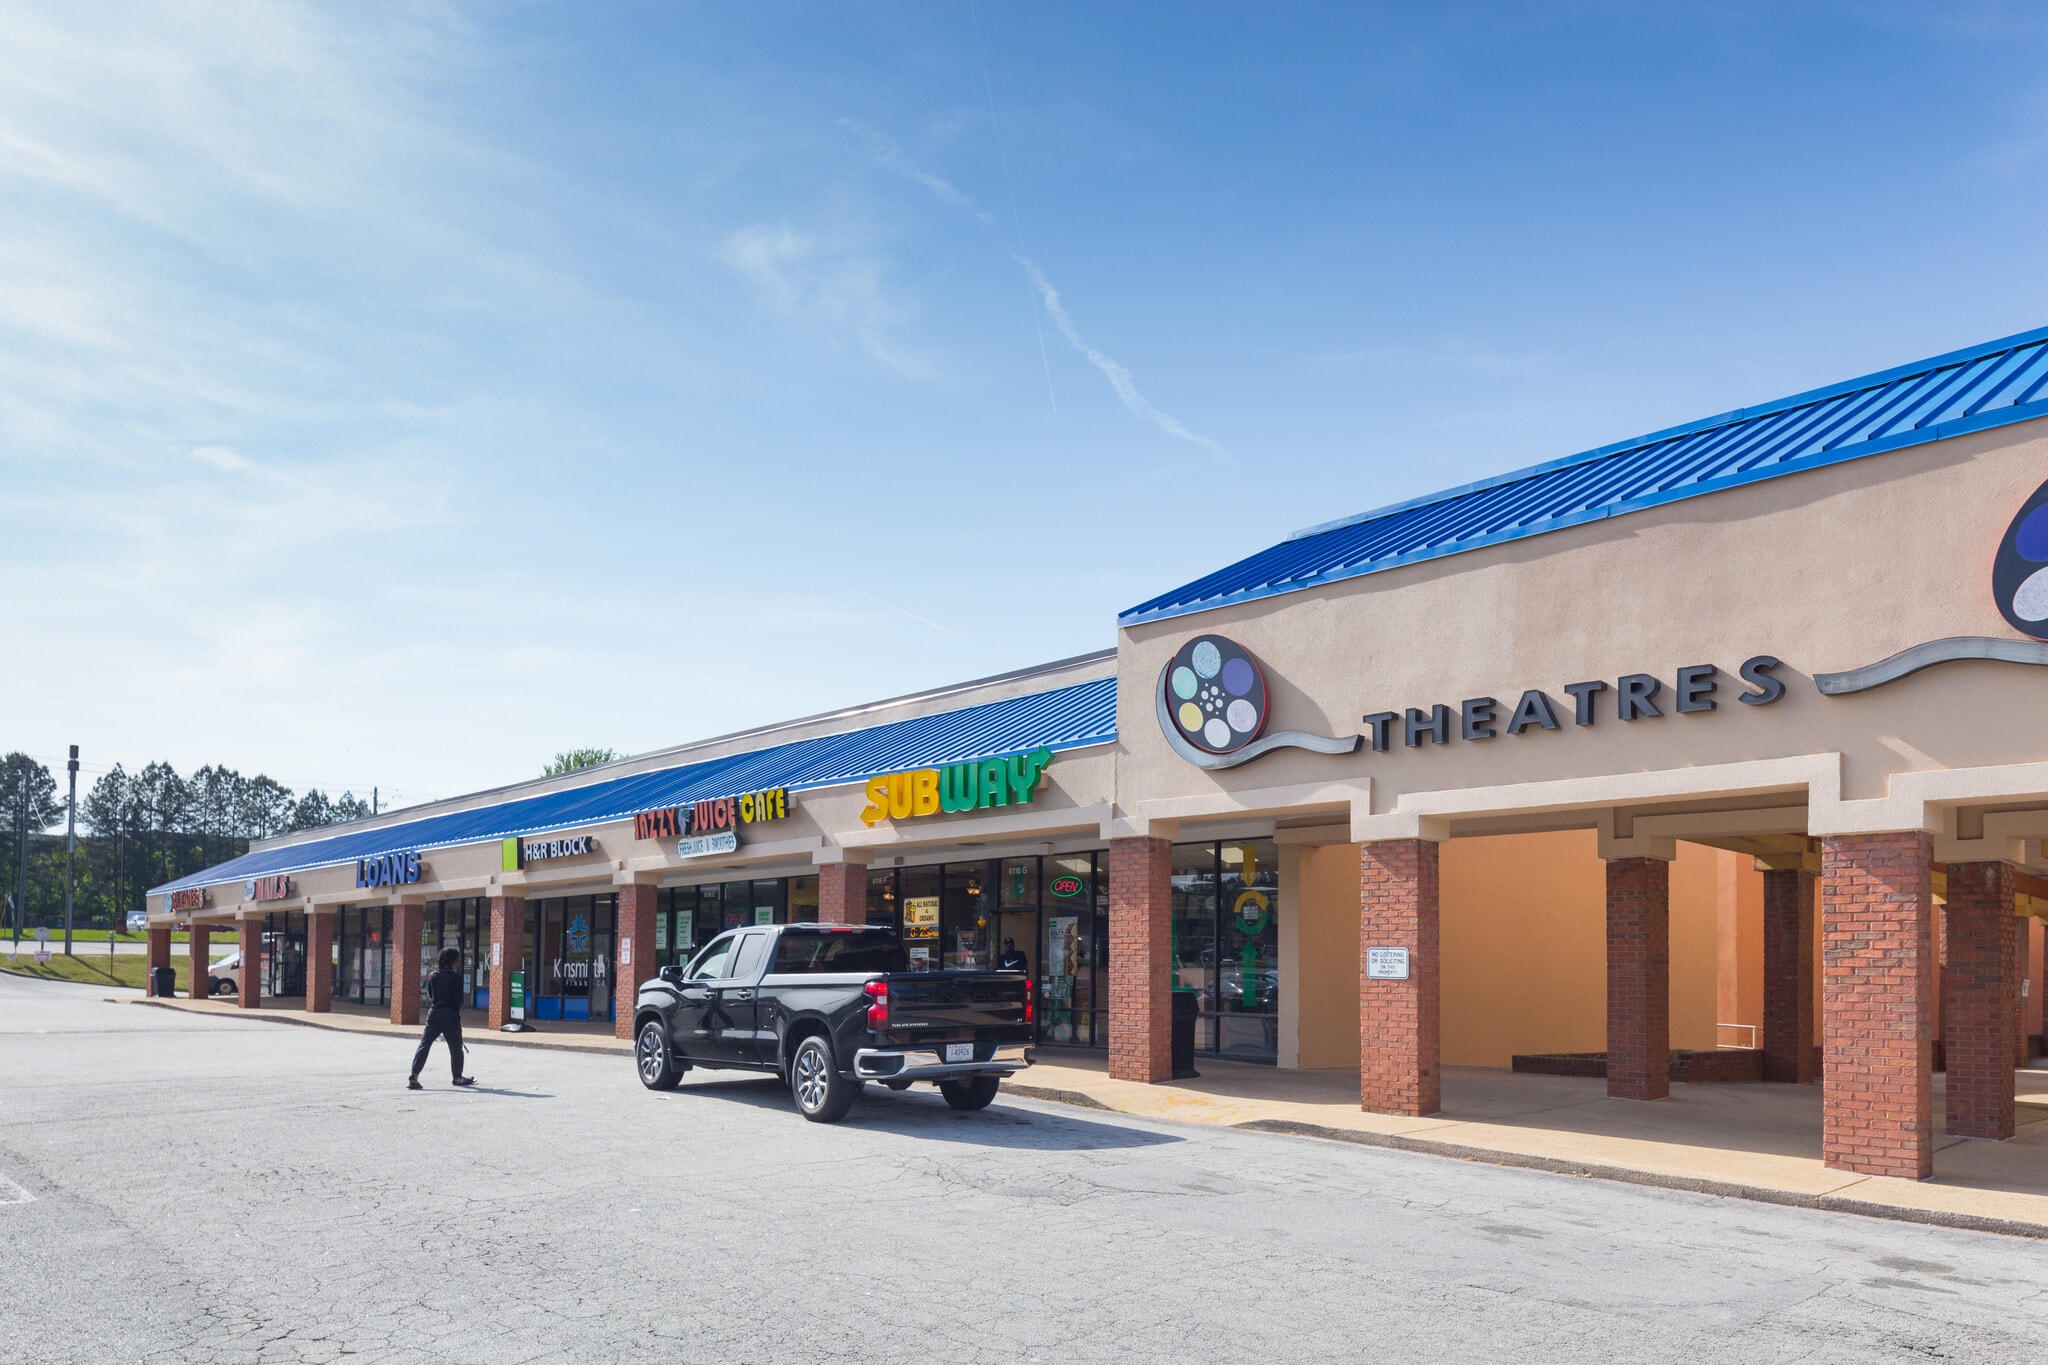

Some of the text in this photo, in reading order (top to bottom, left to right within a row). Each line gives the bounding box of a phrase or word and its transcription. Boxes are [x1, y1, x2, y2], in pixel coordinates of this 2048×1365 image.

[1362, 655, 1786, 752] THEATRES
[860, 745, 1056, 827] SUBWAY
[633, 788, 787, 840] JAZZY JUICE CAFE
[525, 836, 589, 861] H&R BLOCK
[693, 839, 704, 853] JUICE
[356, 851, 420, 889] LOANS
[255, 874, 288, 901] NAILS
[1053, 880, 1079, 893] OPEN
